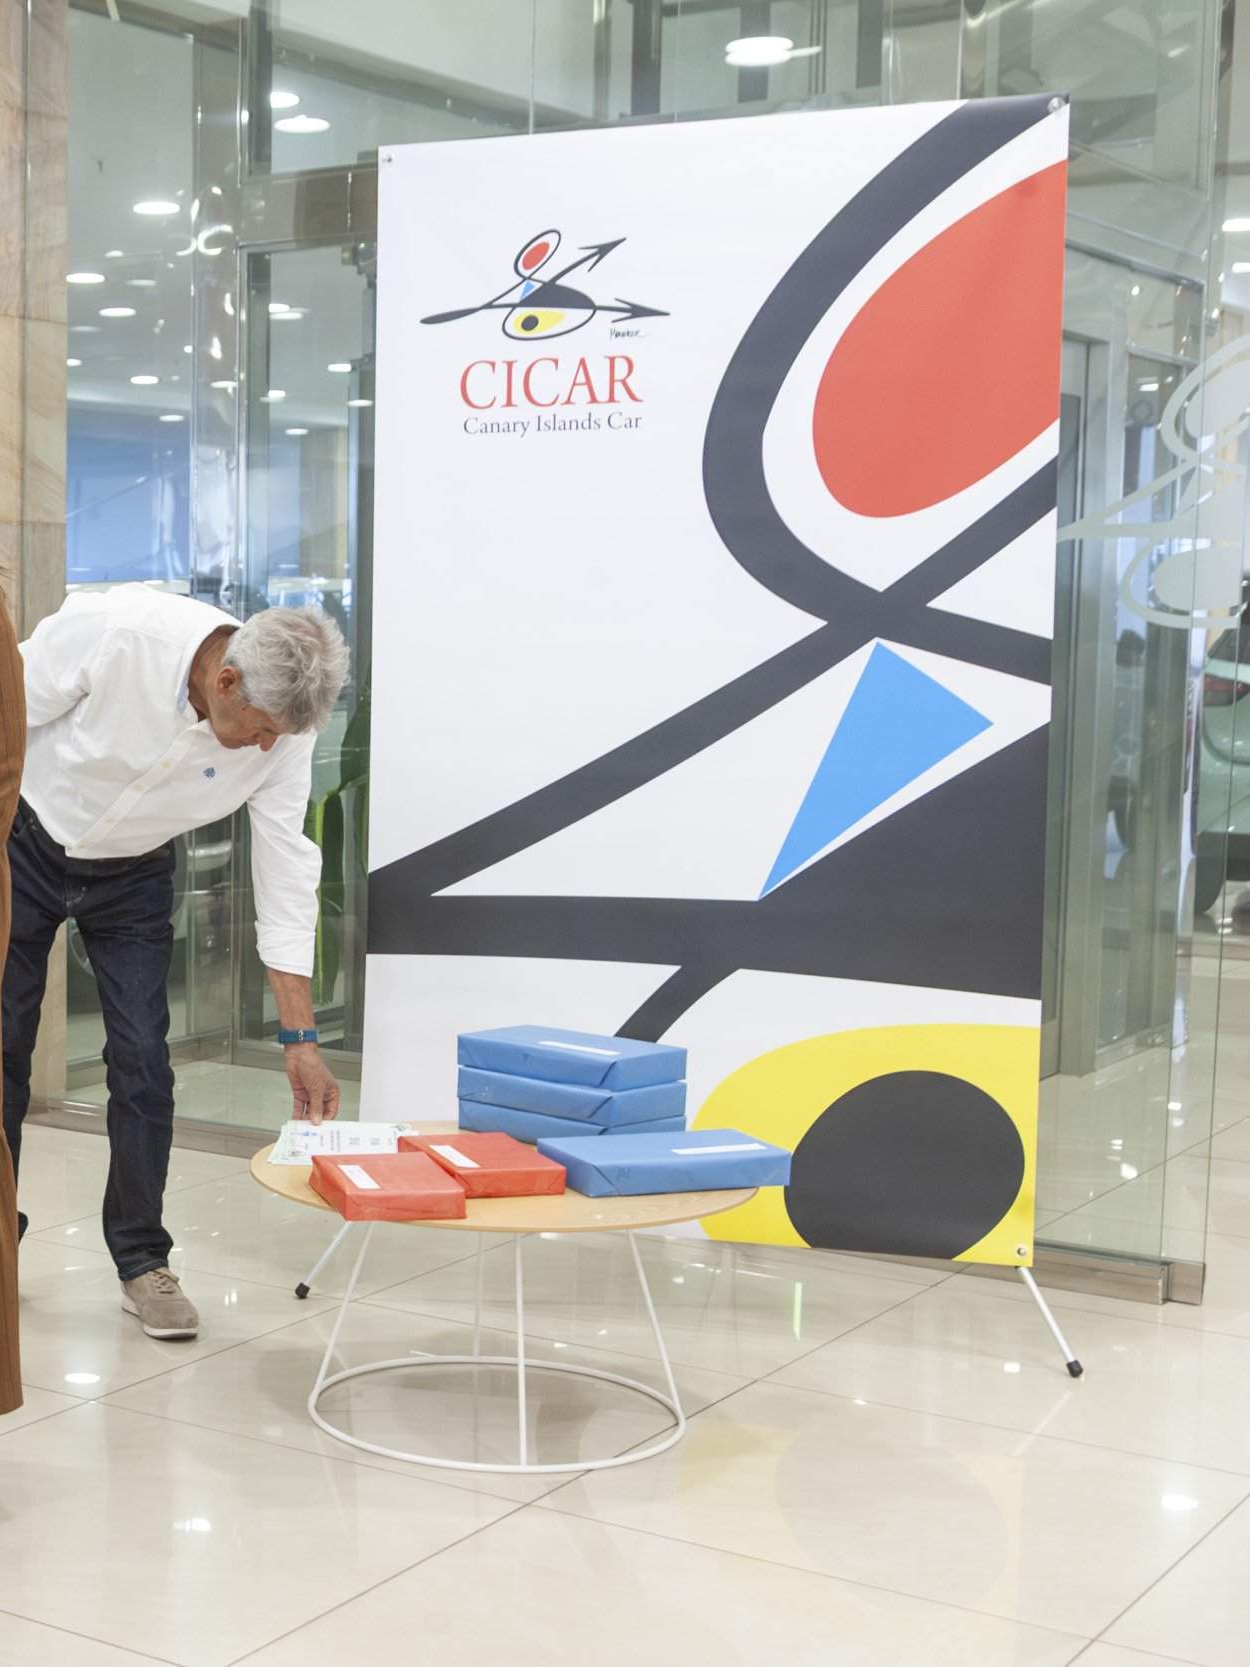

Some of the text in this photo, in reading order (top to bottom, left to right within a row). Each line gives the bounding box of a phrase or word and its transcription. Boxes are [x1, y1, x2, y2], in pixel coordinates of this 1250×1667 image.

[460, 355, 644, 409] CICAR
[463, 411, 642, 438] Canary Islands Car
